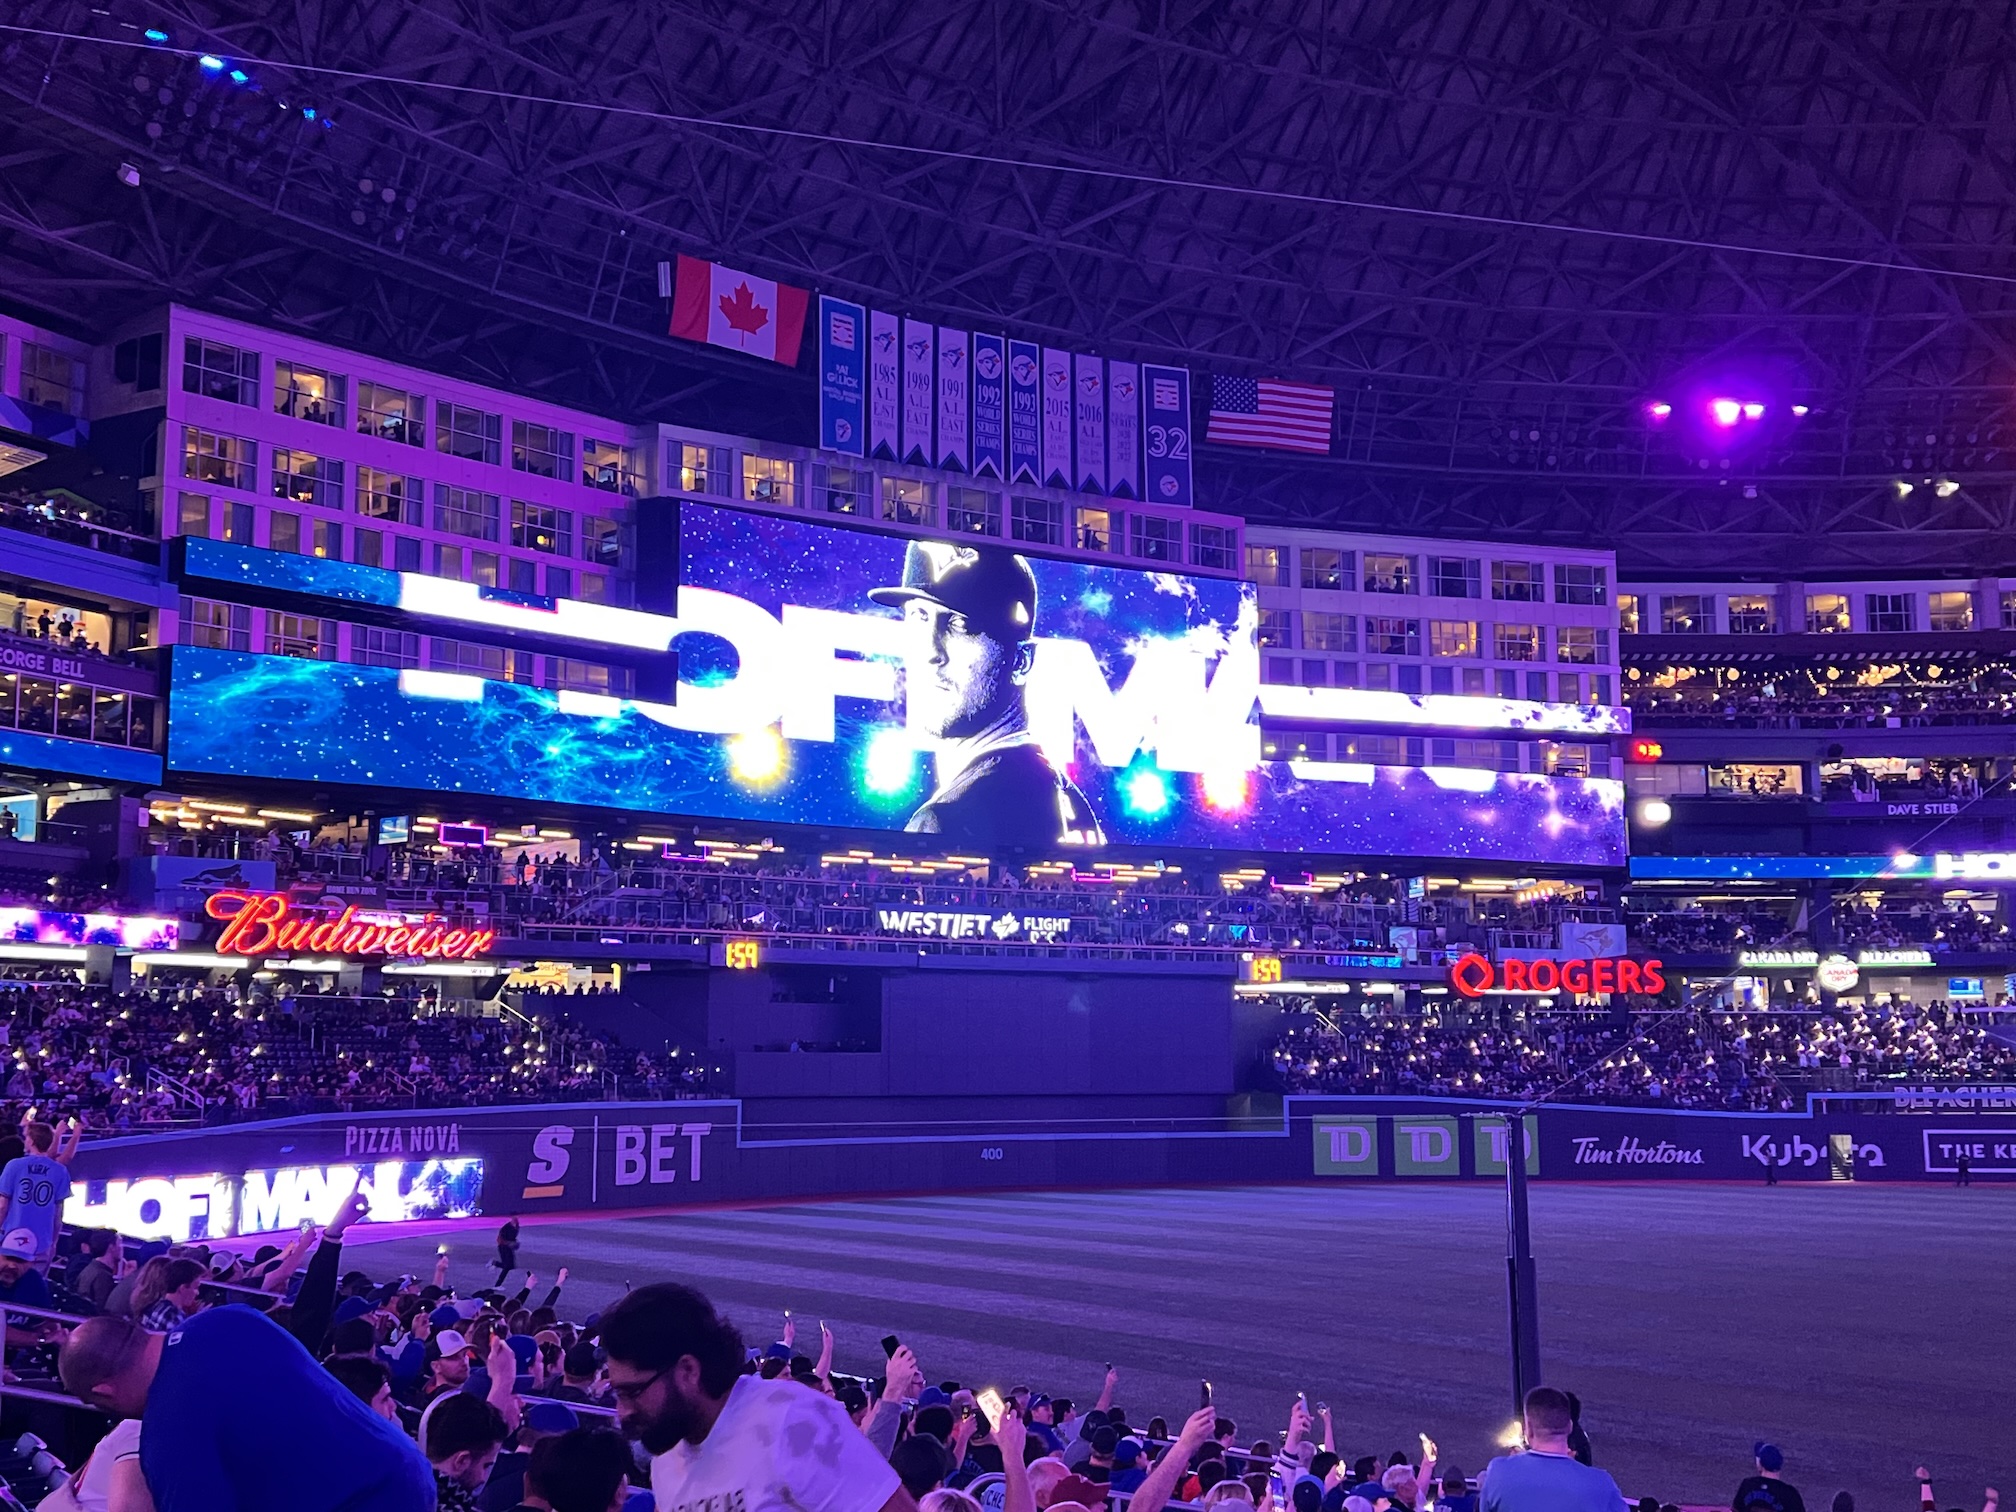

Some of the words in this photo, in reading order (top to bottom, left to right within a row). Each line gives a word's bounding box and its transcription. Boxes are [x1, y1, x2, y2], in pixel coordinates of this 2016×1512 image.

[873, 363, 896, 385] 1985
[906, 371, 930, 392] 1989
[941, 378, 964, 400] 1991
[977, 384, 1001, 406] 1992
[873, 402, 895, 420] EAST
[1013, 391, 1036, 413] 1993
[1045, 397, 1069, 418] 2015
[906, 409, 929, 427] EAST
[976, 405, 1001, 421] WORLD
[1013, 412, 1036, 427] WORLD
[1078, 402, 1102, 424] 2016
[941, 416, 964, 433] EAST
[976, 421, 1001, 436] SERIES
[1013, 427, 1036, 442] SERIES
[976, 435, 1001, 450] CHAMPS
[1013, 442, 1037, 457] CHAMPS
[1147, 424, 1188, 461] 32
[52, 657, 85, 678] BELL
[1887, 804, 1920, 816] DAVE
[1923, 803, 1959, 815] STIEB
[205, 889, 495, 960] Budweiser
[879, 910, 992, 939] WESTJET
[1023, 916, 1071, 931] FLIGHT
[725, 941, 758, 970] 1:59
[1740, 951, 1792, 964] CANADA
[1793, 951, 1819, 964] DRY
[1860, 951, 1931, 964] BLEACHERS
[1252, 958, 1282, 982] 1:59
[1503, 958, 1666, 995] ROGERS
[345, 1125, 403, 1157] PIZZA
[410, 1122, 460, 1153] NOVA
[1319, 1125, 1371, 1163] TD
[1399, 1125, 1452, 1163] TD
[1571, 1136, 1613, 1165] Tim
[1615, 1134, 1704, 1165] Hortons
[615, 1122, 712, 1186] BET
[980, 1147, 1004, 1160] 400
[1938, 1143, 1986, 1159] THE
[27, 1164, 51, 1176] KIRK
[18, 1177, 54, 1207] 30
